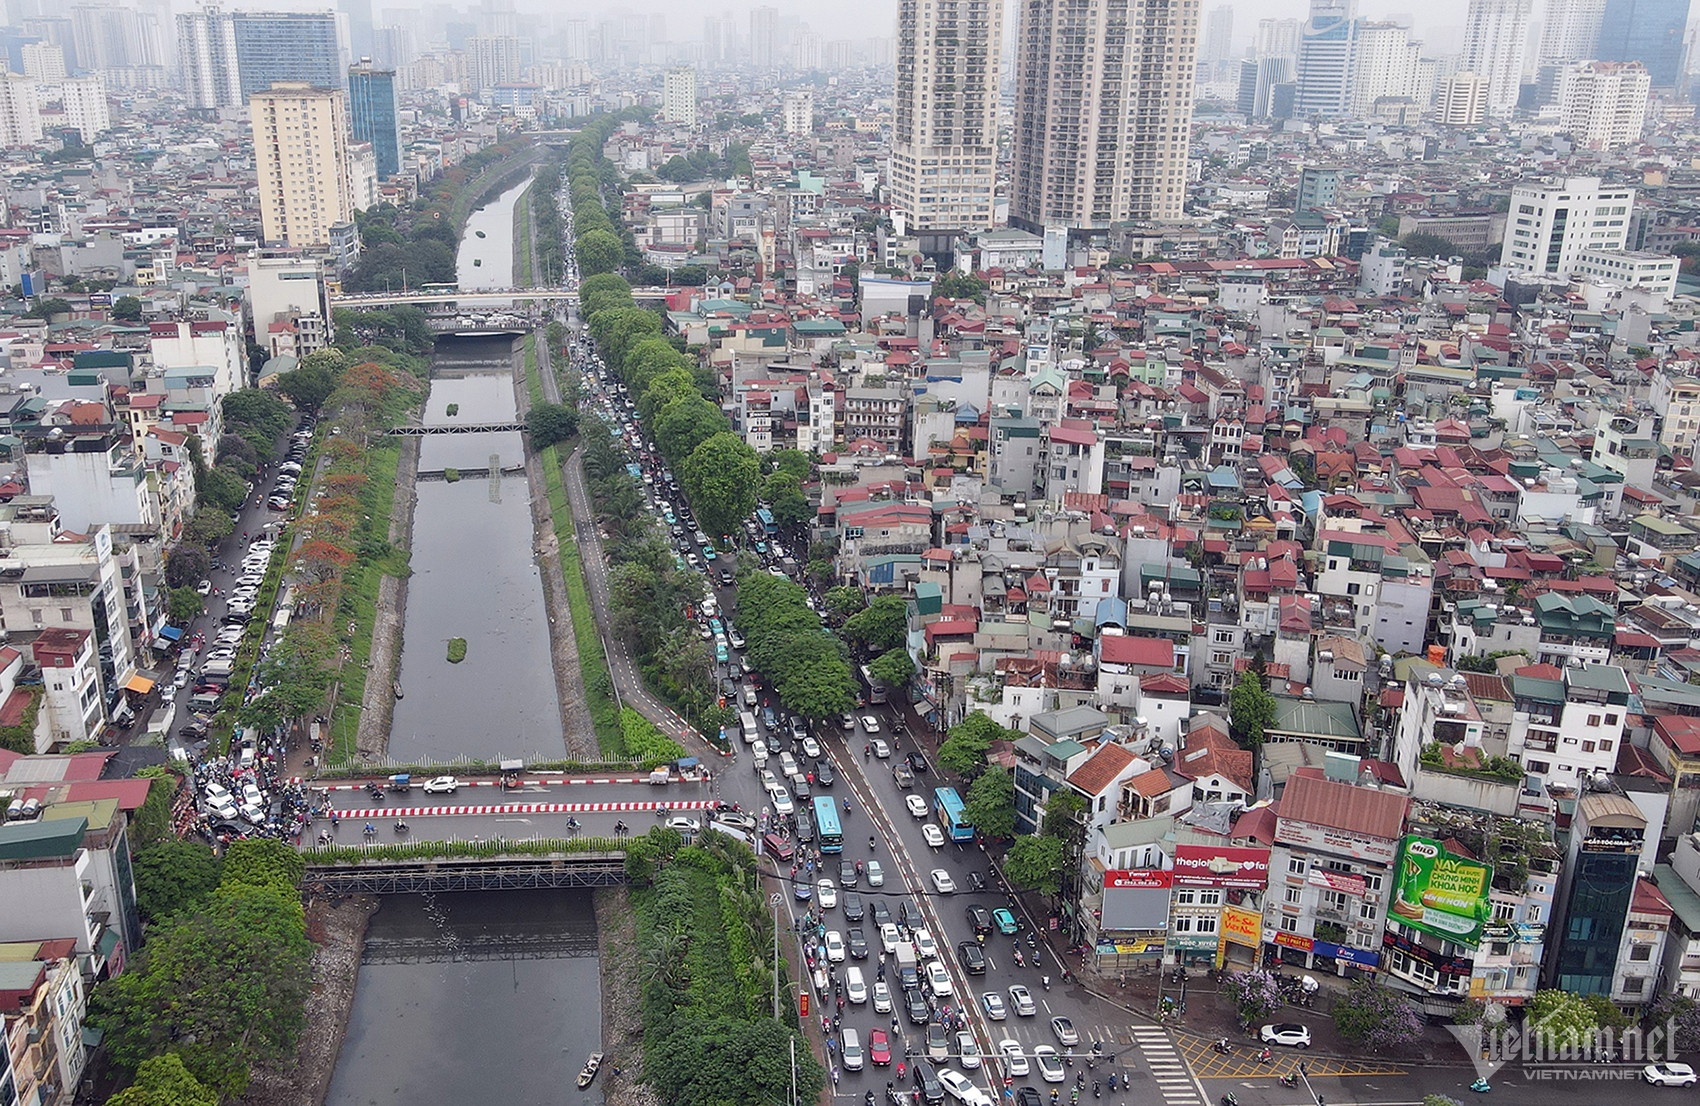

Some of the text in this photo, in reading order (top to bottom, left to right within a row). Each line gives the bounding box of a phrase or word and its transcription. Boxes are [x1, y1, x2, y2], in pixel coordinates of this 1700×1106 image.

[1411, 844, 1434, 855] MILO
[1434, 858, 1461, 872] NAY
[1432, 872, 1480, 885] CHỨNG MINH
[1430, 880, 1478, 894] KHOA HỌC
